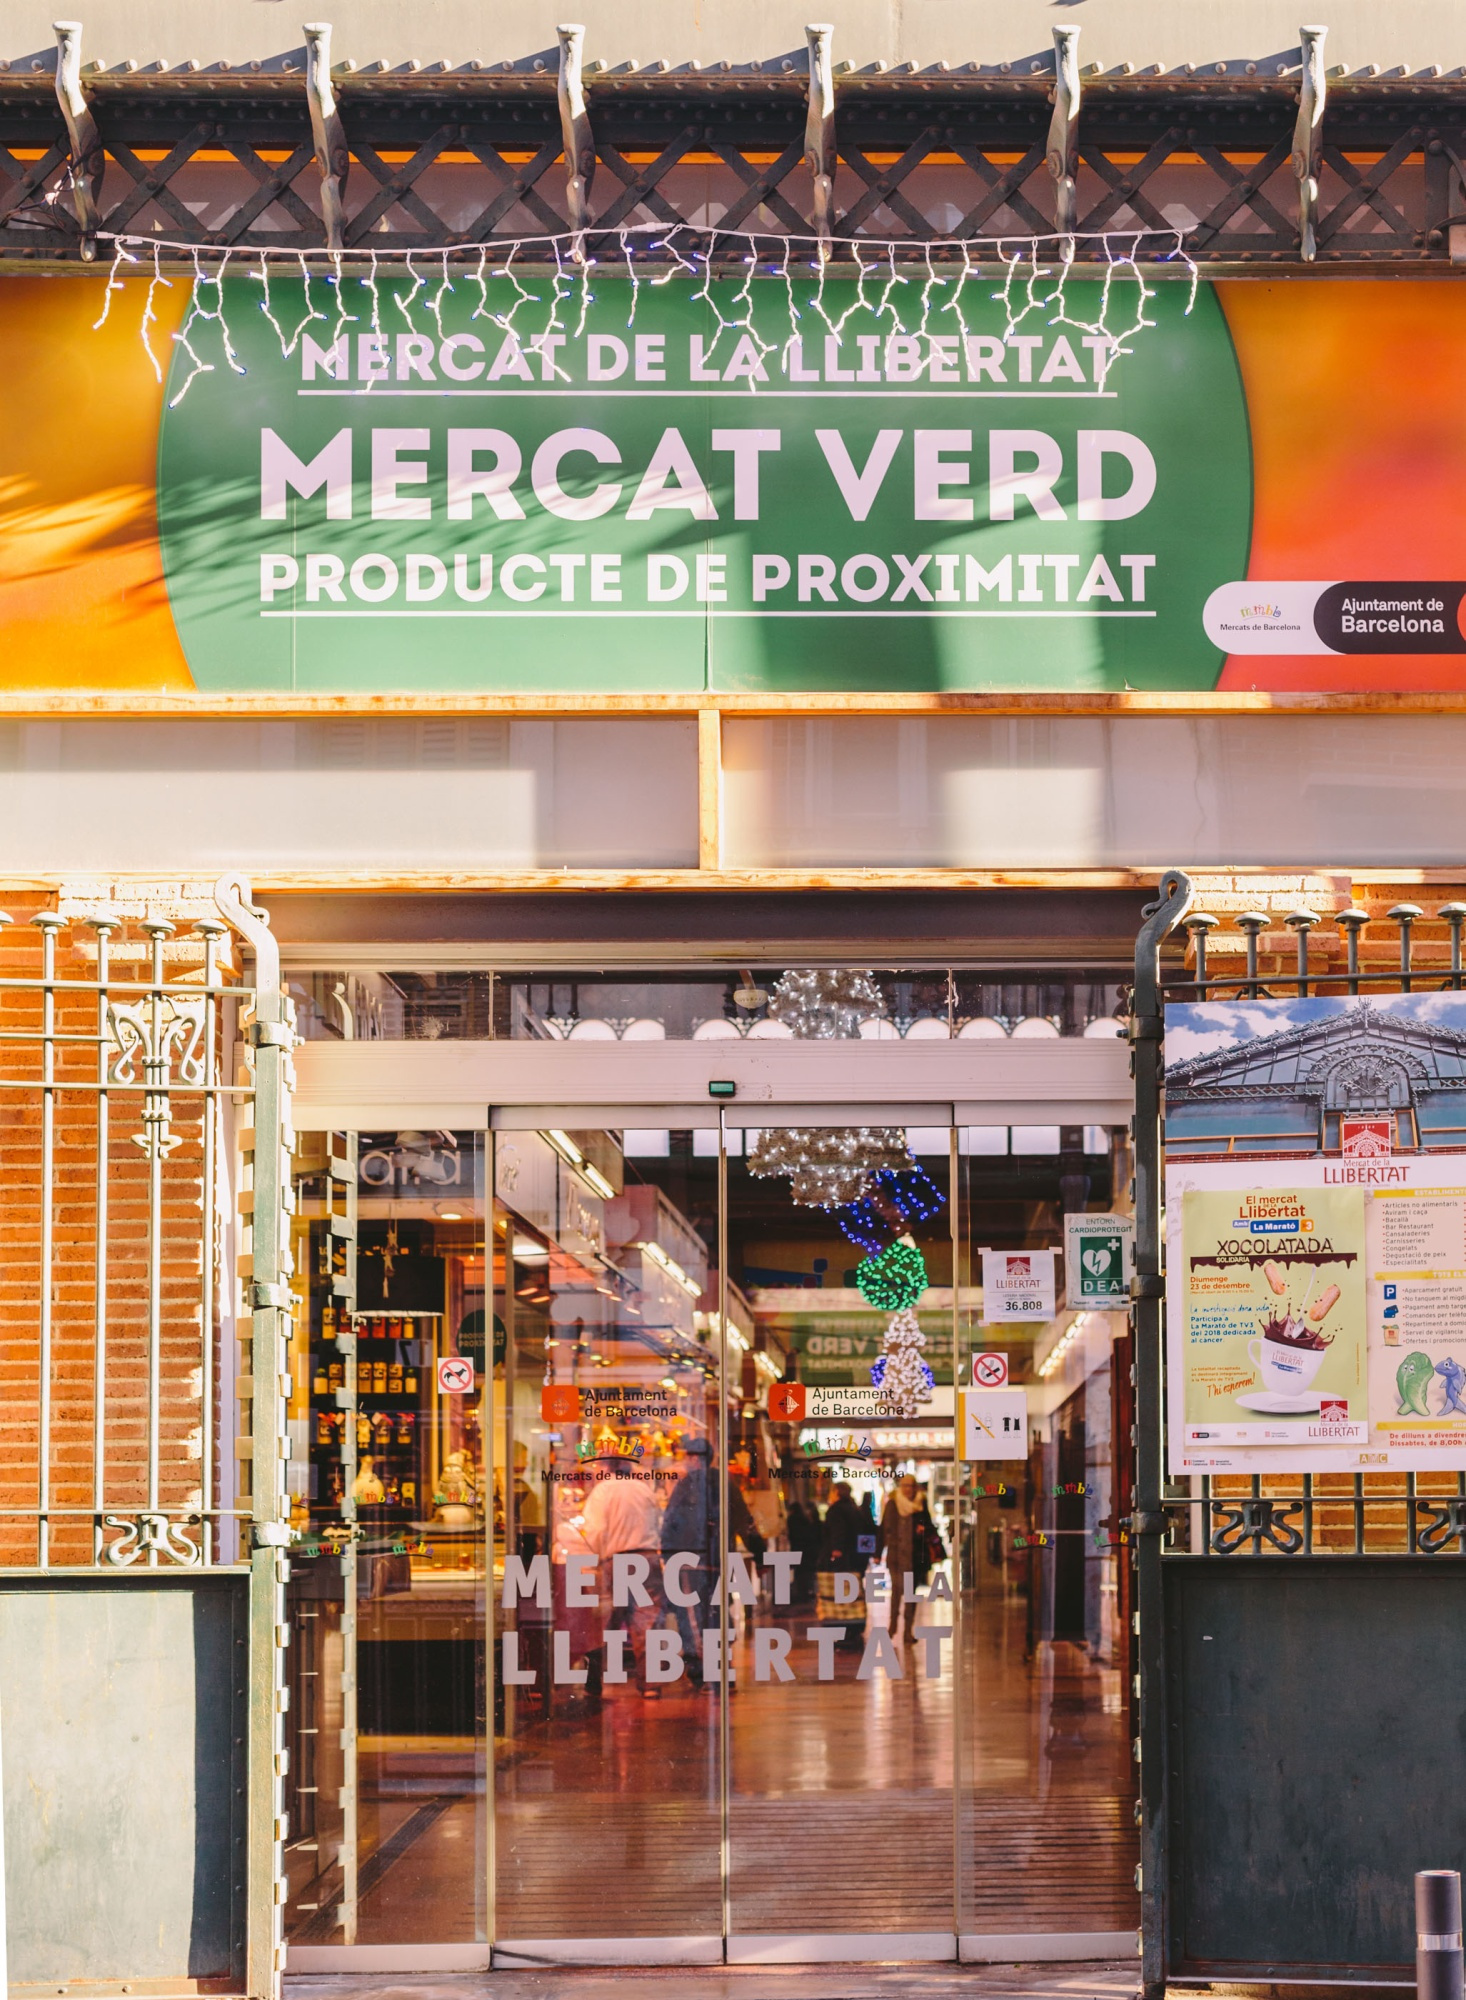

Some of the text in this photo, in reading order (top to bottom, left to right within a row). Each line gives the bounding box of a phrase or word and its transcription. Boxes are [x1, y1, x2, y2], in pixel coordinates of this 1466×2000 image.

[302, 333, 1118, 382] MERCAT DE LA LLIBERTAT
[260, 427, 1157, 522] MERCAT VERD
[260, 554, 1156, 603] PRODUCTE DE PROXIMITAT
[1342, 598, 1444, 614] Ajuntament de
[1220, 623, 1301, 631] Mercats de Barcelona
[1341, 616, 1445, 633] Barcelona
[1343, 1159, 1370, 1168] Mercat
[1324, 1166, 1410, 1184] LLIBERTAT
[1246, 1194, 1297, 1204] El mercat
[1240, 1205, 1306, 1218] Llibertat
[1265, 1222, 1296, 1230] Marató
[1217, 1237, 1334, 1255] XOCOLATADA
[996, 1280, 1042, 1288] LLIBERTAT
[1084, 1280, 1120, 1292] DEA
[1005, 1301, 1042, 1310] 36.808
[1223, 1372, 1256, 1394] esperem!
[585, 1389, 667, 1402] Ajuntament
[812, 1387, 895, 1400] Ajuntament
[584, 1405, 678, 1416] de Barcelona
[812, 1404, 904, 1416] de Barcelona
[1308, 1426, 1360, 1437] LLIBERTAT
[1360, 1454, 1387, 1463] AMC
[541, 1470, 678, 1481] Mercats de Barcelona
[768, 1468, 905, 1478] Mercats de Barcelona
[501, 1551, 953, 1609] MERCAT DE LA
[502, 1625, 953, 1685] LLIBERTAT
